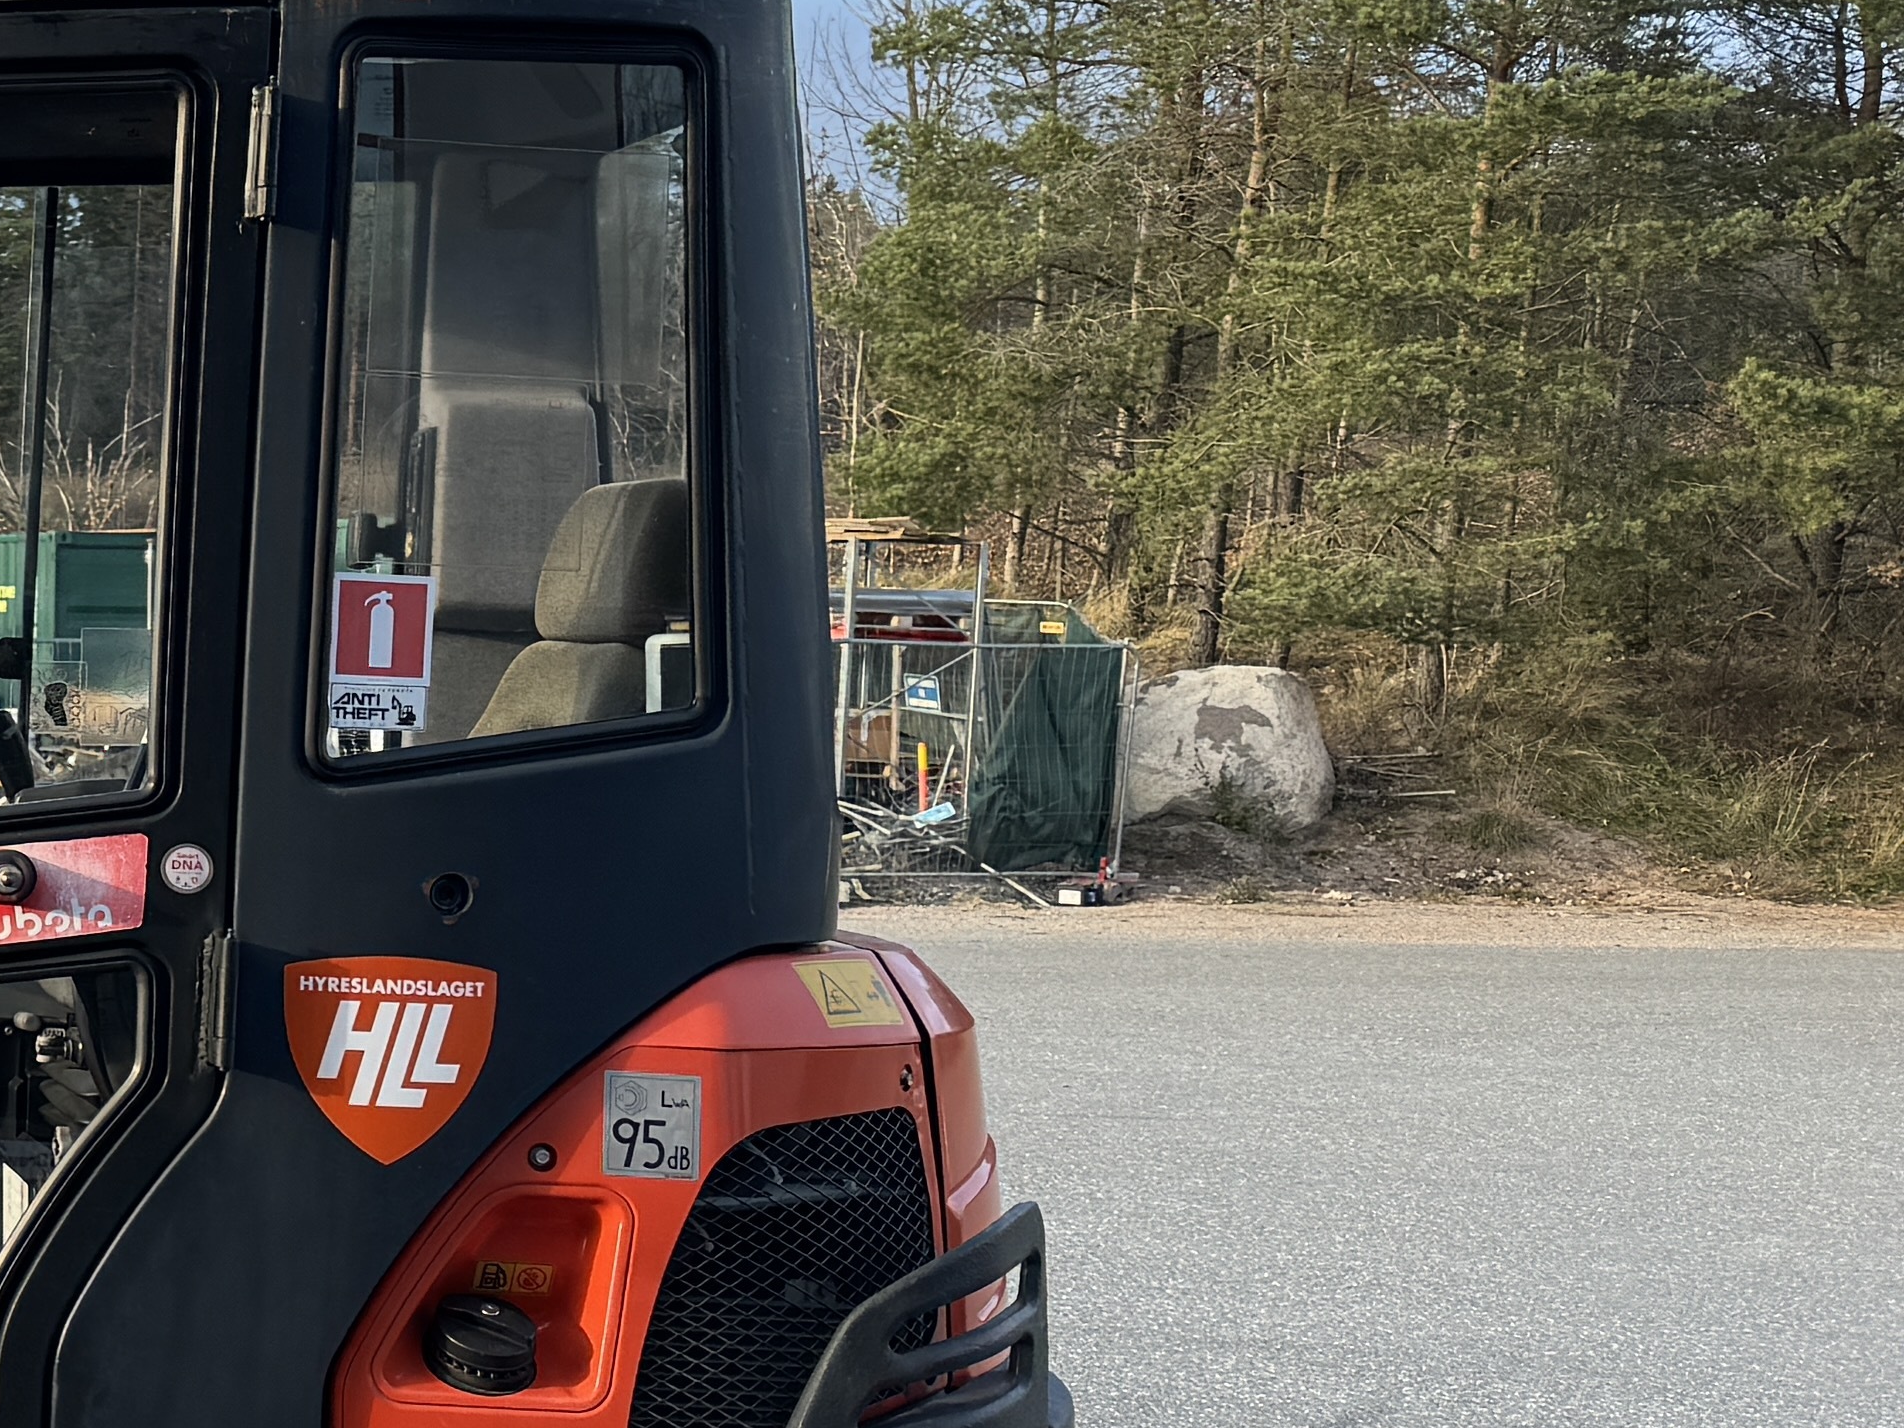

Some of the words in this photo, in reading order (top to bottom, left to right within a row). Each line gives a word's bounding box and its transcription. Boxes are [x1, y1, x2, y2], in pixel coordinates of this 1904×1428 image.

[333, 692, 381, 706] ANTI
[331, 706, 390, 721] THEFT
[171, 859, 204, 872] DNA
[299, 974, 485, 998] HYRESLANDSLAGET
[612, 1117, 667, 1170] 95
[667, 1145, 691, 1171] dB
